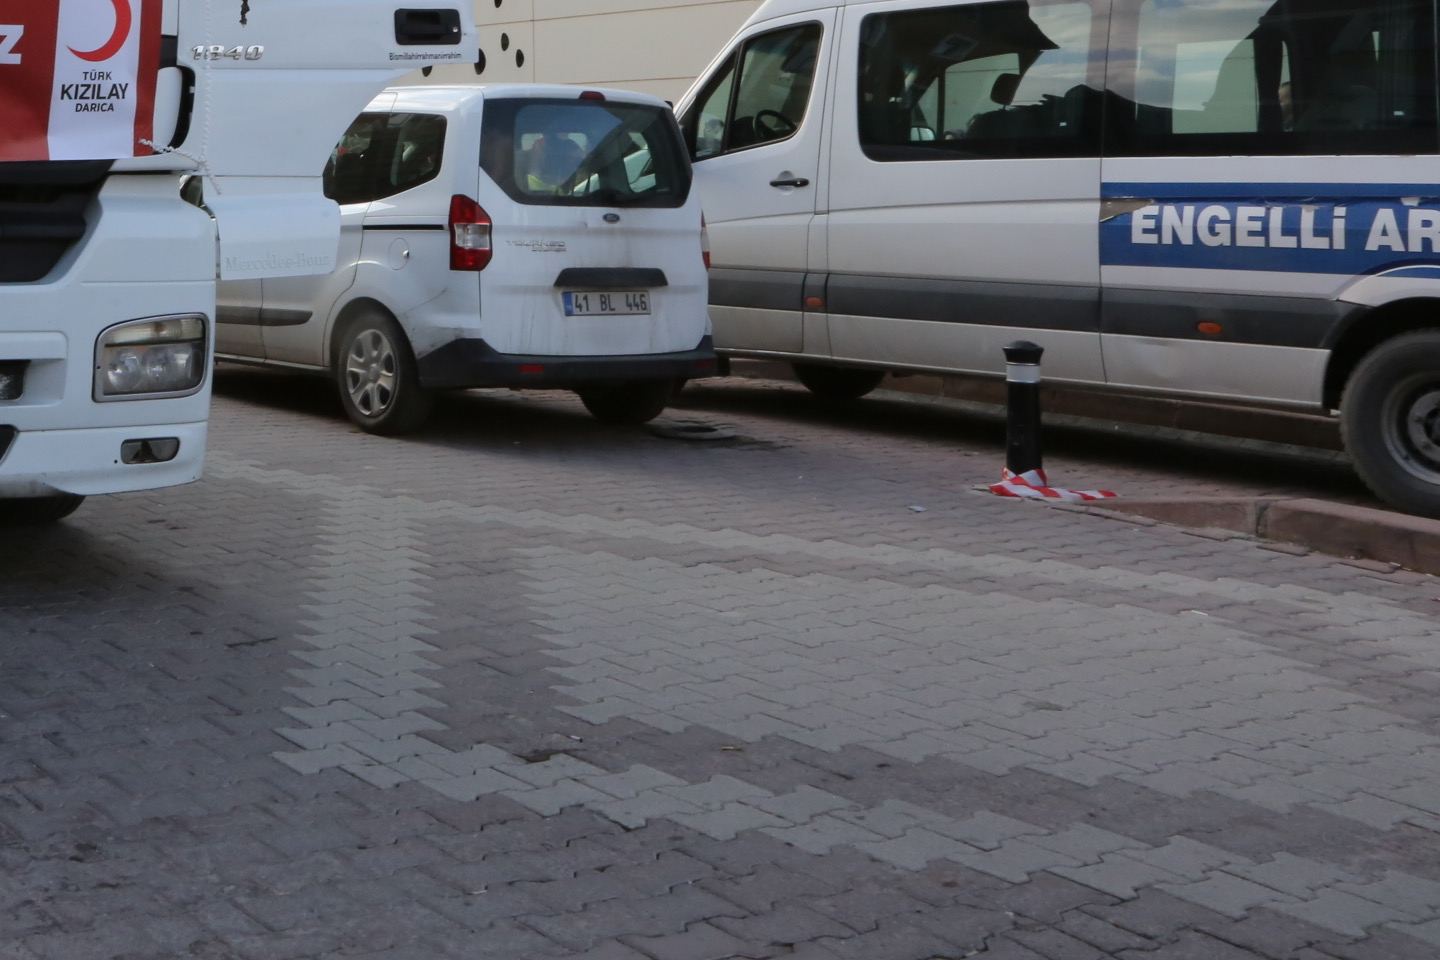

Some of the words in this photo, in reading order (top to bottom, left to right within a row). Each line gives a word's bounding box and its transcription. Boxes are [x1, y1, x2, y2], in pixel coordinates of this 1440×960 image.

[192, 44, 264, 61] 1840
[82, 69, 112, 81] TÜRK
[60, 83, 129, 100] KIZILAY
[75, 102, 114, 112] DARICA
[1131, 204, 1346, 250] ENGELLİ
[1364, 208, 1440, 252] AR
[225, 252, 330, 271] Mercedes-Benz
[574, 294, 590, 312] 41
[600, 294, 616, 311] BL
[626, 293, 647, 311] 446
